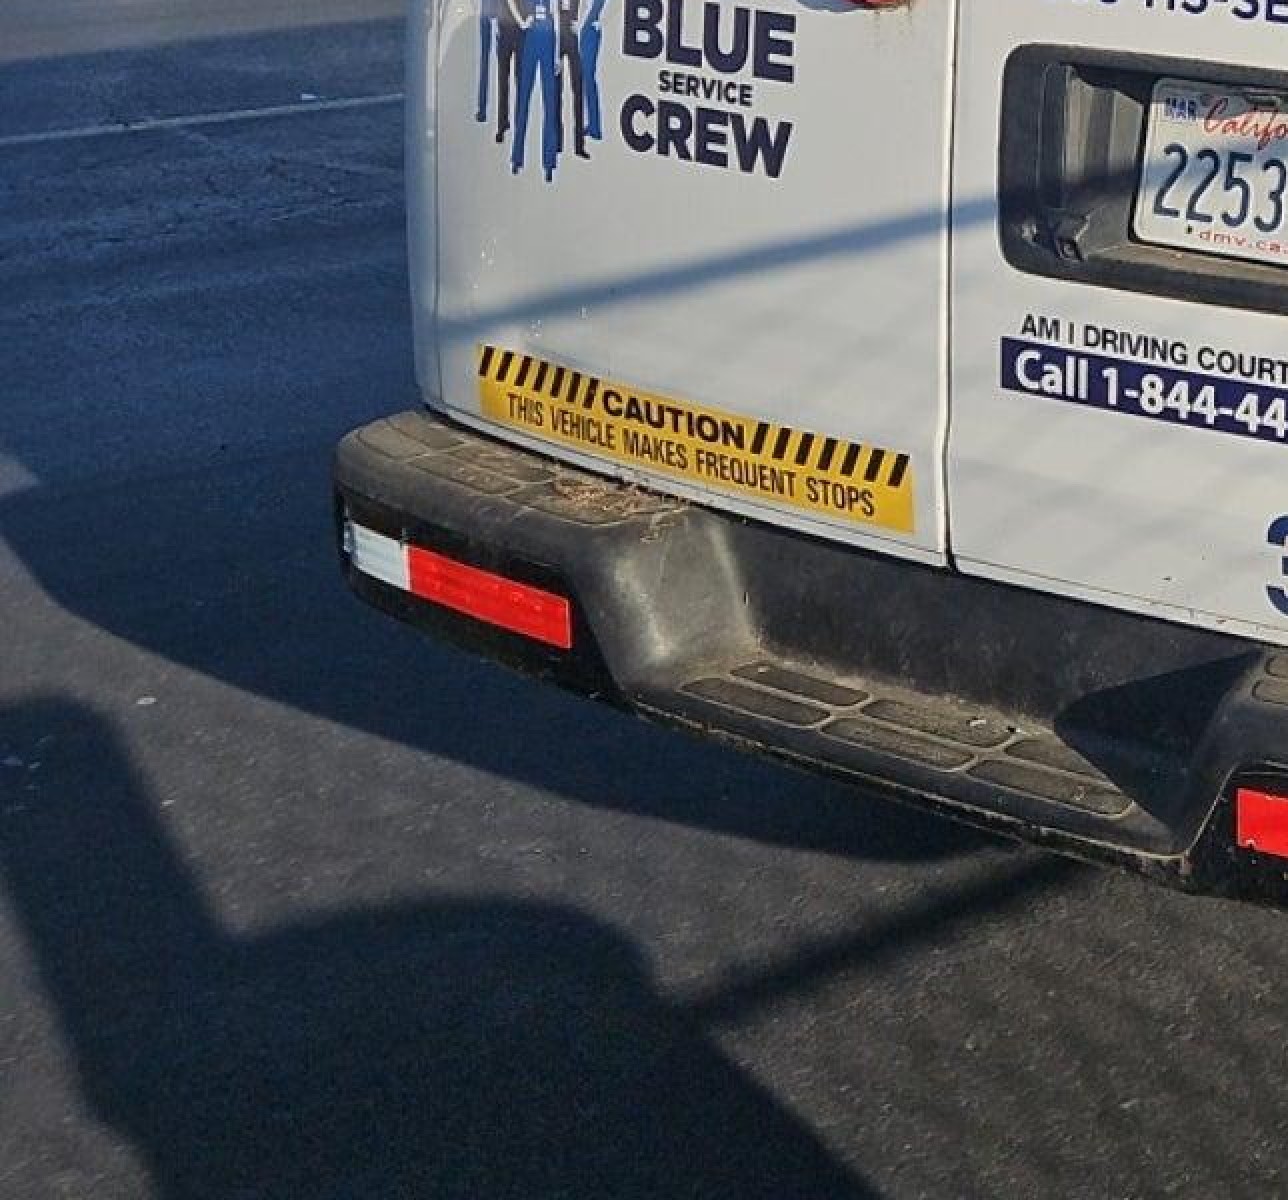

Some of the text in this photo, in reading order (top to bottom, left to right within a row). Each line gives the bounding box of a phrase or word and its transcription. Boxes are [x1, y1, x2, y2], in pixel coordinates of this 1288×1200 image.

[657, 68, 753, 108] SERVICE
[619, 93, 793, 179] CREW
[1021, 313, 1061, 342] AM
[1068, 322, 1074, 345] I
[1083, 325, 1189, 366] DRIVING
[1015, 349, 1089, 400] Call
[601, 389, 745, 449] CAUTION
[507, 392, 876, 517] THIS VEHICLE MAKES FREQUENT STOPS
